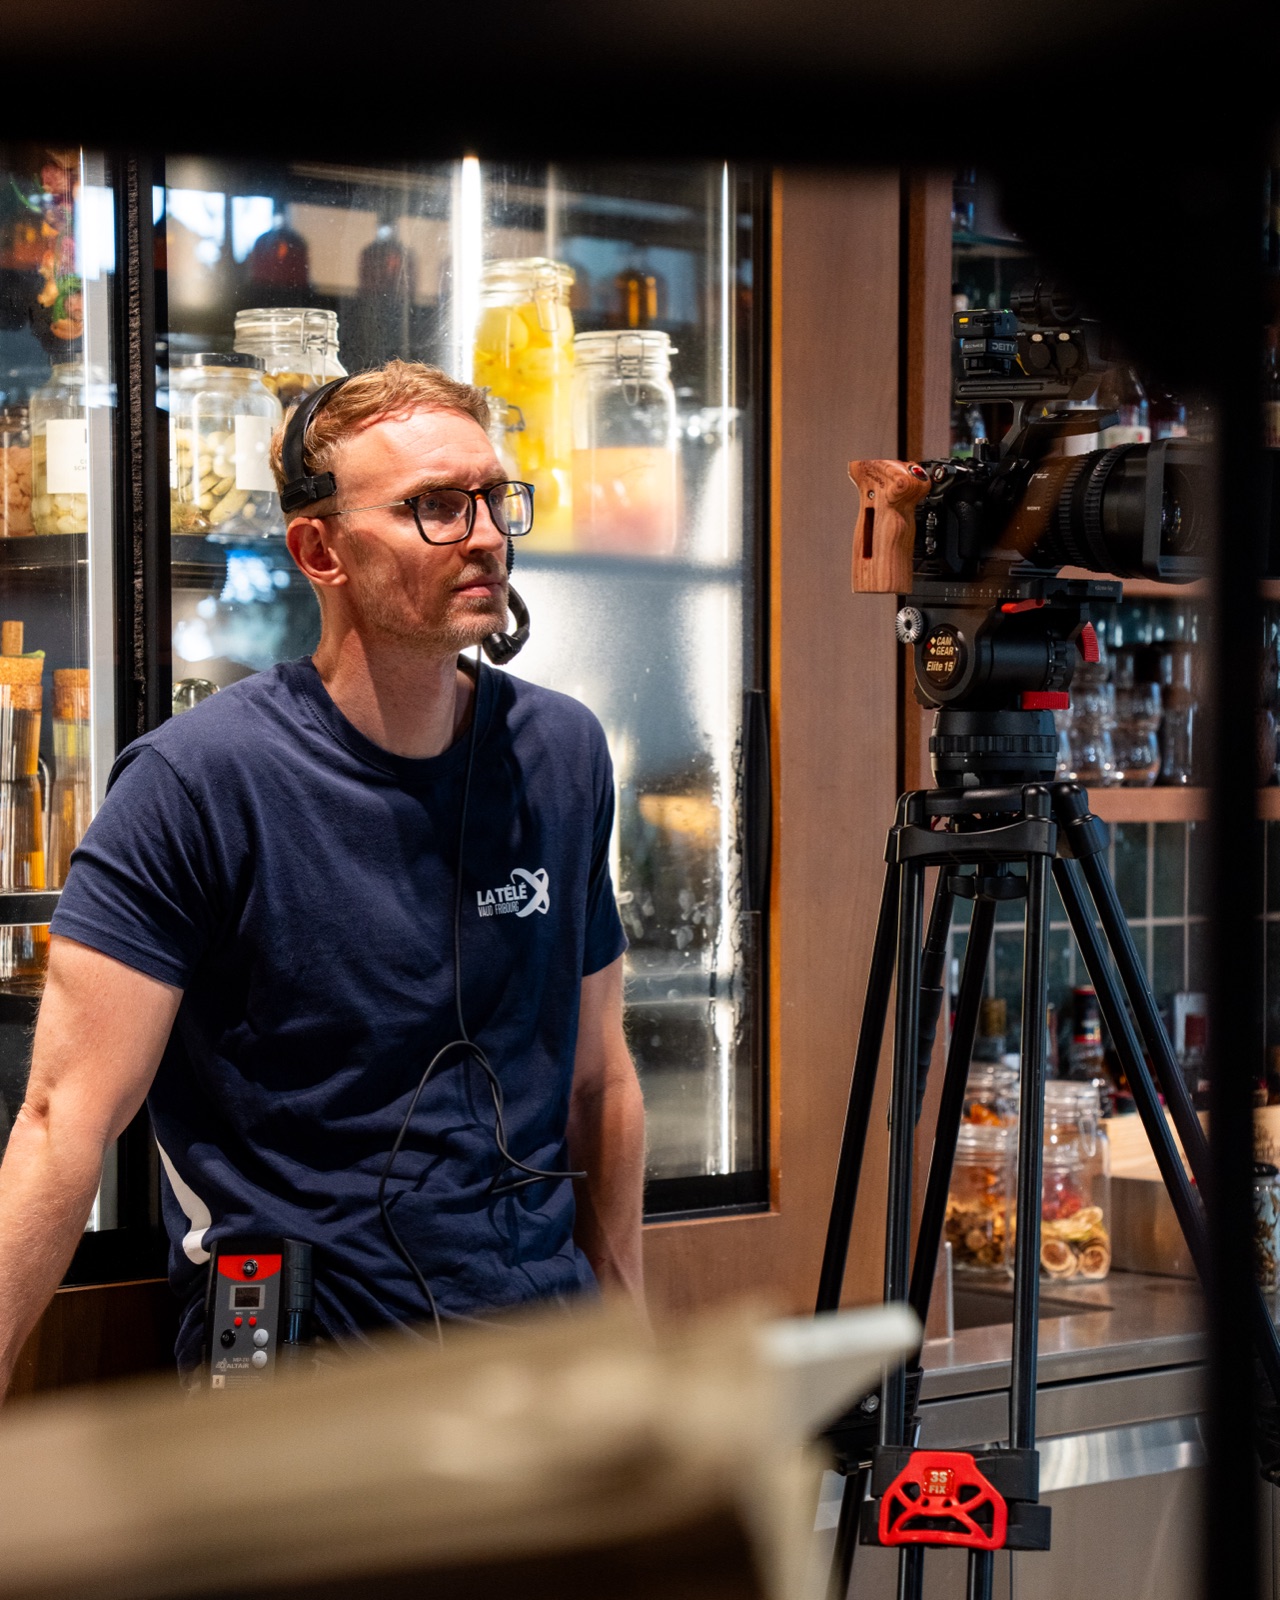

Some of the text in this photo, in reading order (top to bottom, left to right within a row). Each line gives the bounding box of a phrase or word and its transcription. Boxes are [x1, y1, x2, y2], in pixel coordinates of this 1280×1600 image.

[991, 342, 1015, 352] DEITY
[936, 637, 952, 646] CAM
[936, 646, 954, 656] GEAR
[926, 661, 954, 672] Elite 15
[477, 882, 528, 906] LA TÉLÉ
[930, 1471, 948, 1483] 3S
[929, 1485, 946, 1494] FIX
